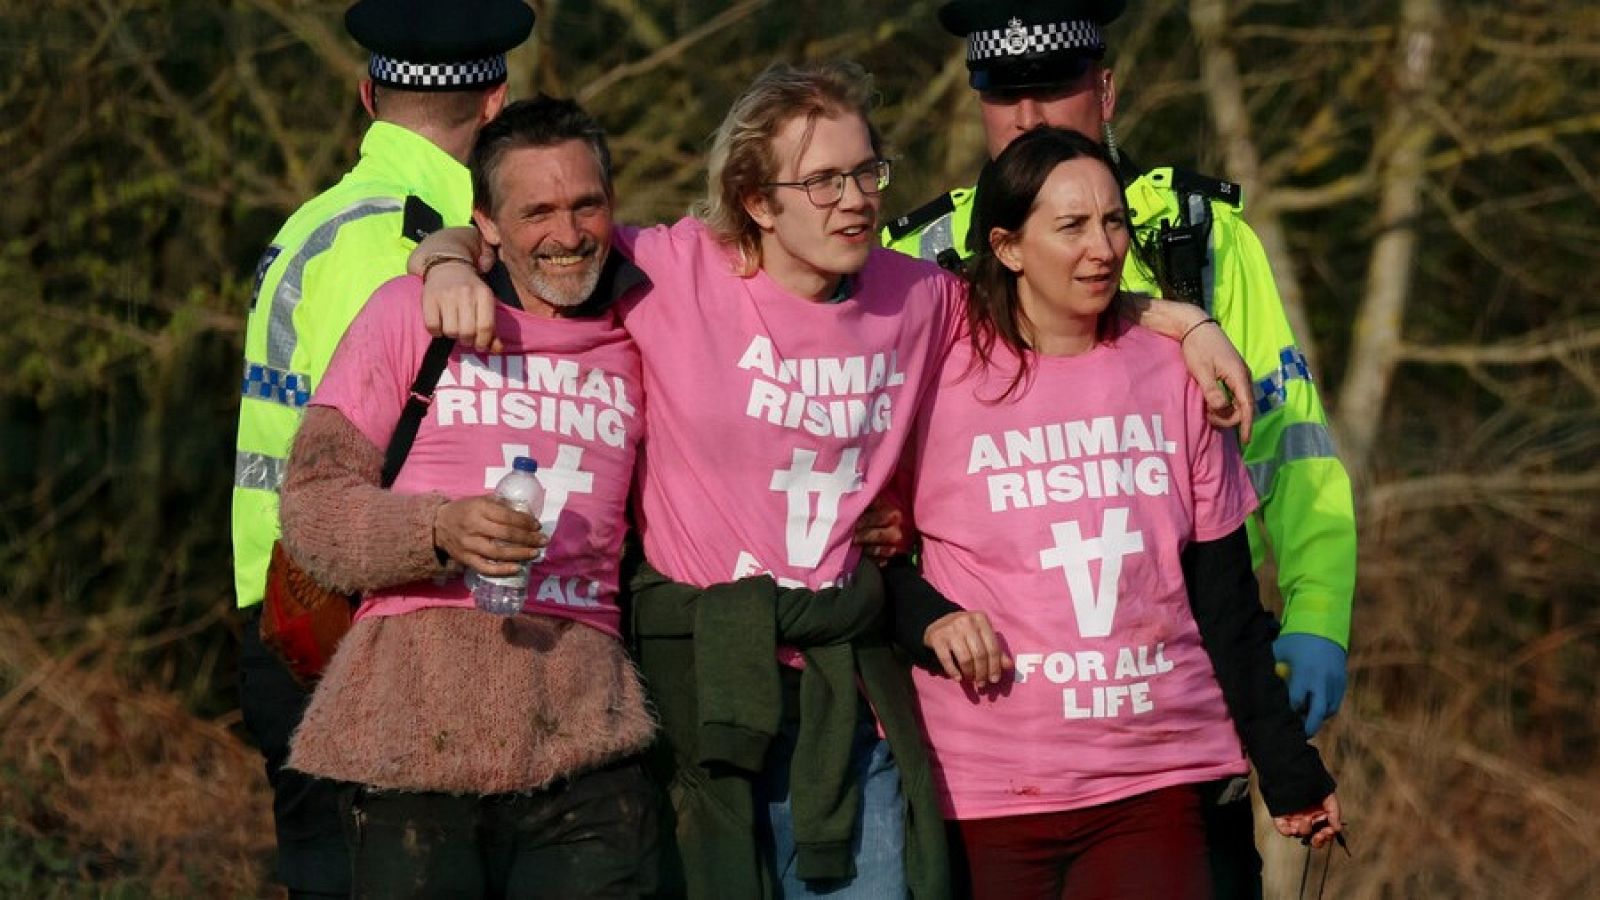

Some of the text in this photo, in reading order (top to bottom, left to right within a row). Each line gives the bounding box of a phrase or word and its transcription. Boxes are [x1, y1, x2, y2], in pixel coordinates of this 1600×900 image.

[437, 389, 626, 448] RISING
[746, 378, 893, 438] RISING
[967, 414, 1176, 474] ANIMAL
[987, 456, 1169, 512] RISING
[1015, 642, 1174, 684] FOR ALL
[1063, 682, 1153, 719] LIFE
